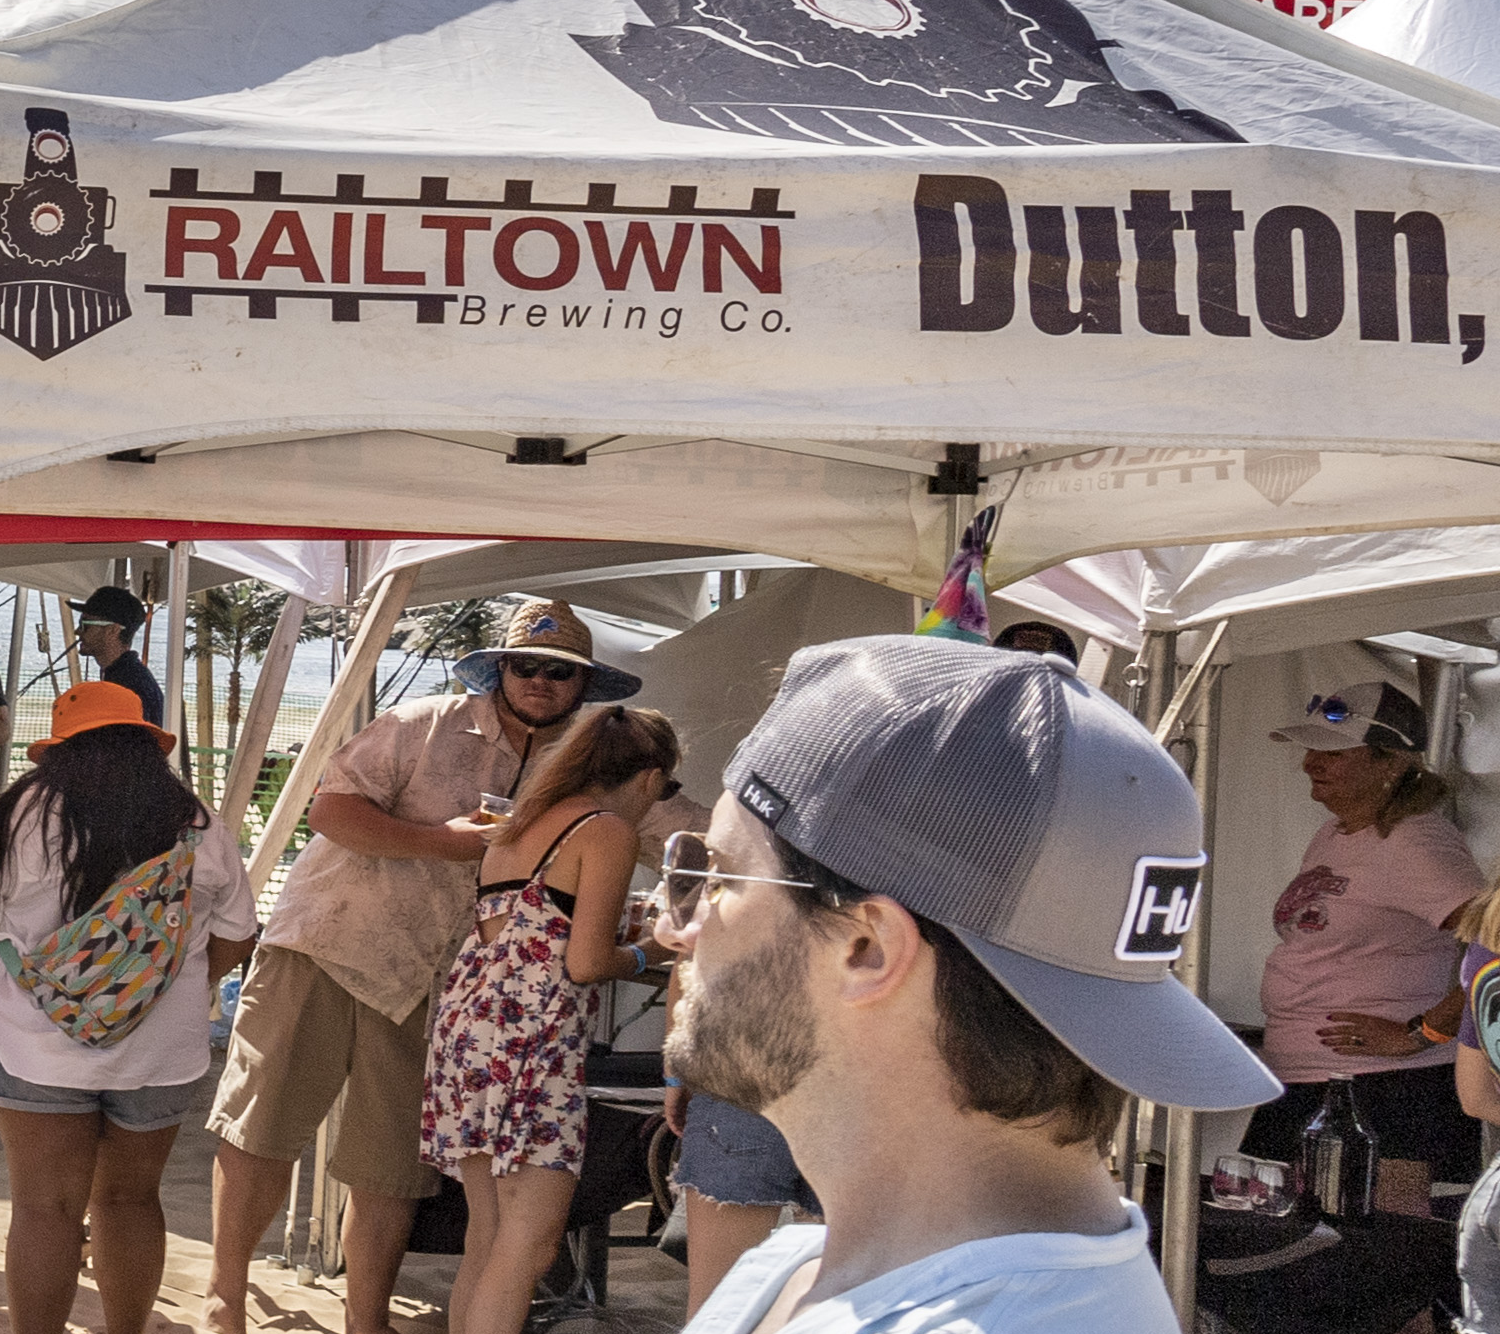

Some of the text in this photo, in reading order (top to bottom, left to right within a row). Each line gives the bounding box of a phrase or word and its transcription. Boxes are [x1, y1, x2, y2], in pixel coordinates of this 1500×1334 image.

[163, 205, 784, 295] RAILTOWN
[915, 174, 1486, 366] Dutton,
[460, 294, 793, 338] Brewing Co.
[1137, 882, 1202, 935] Hu
